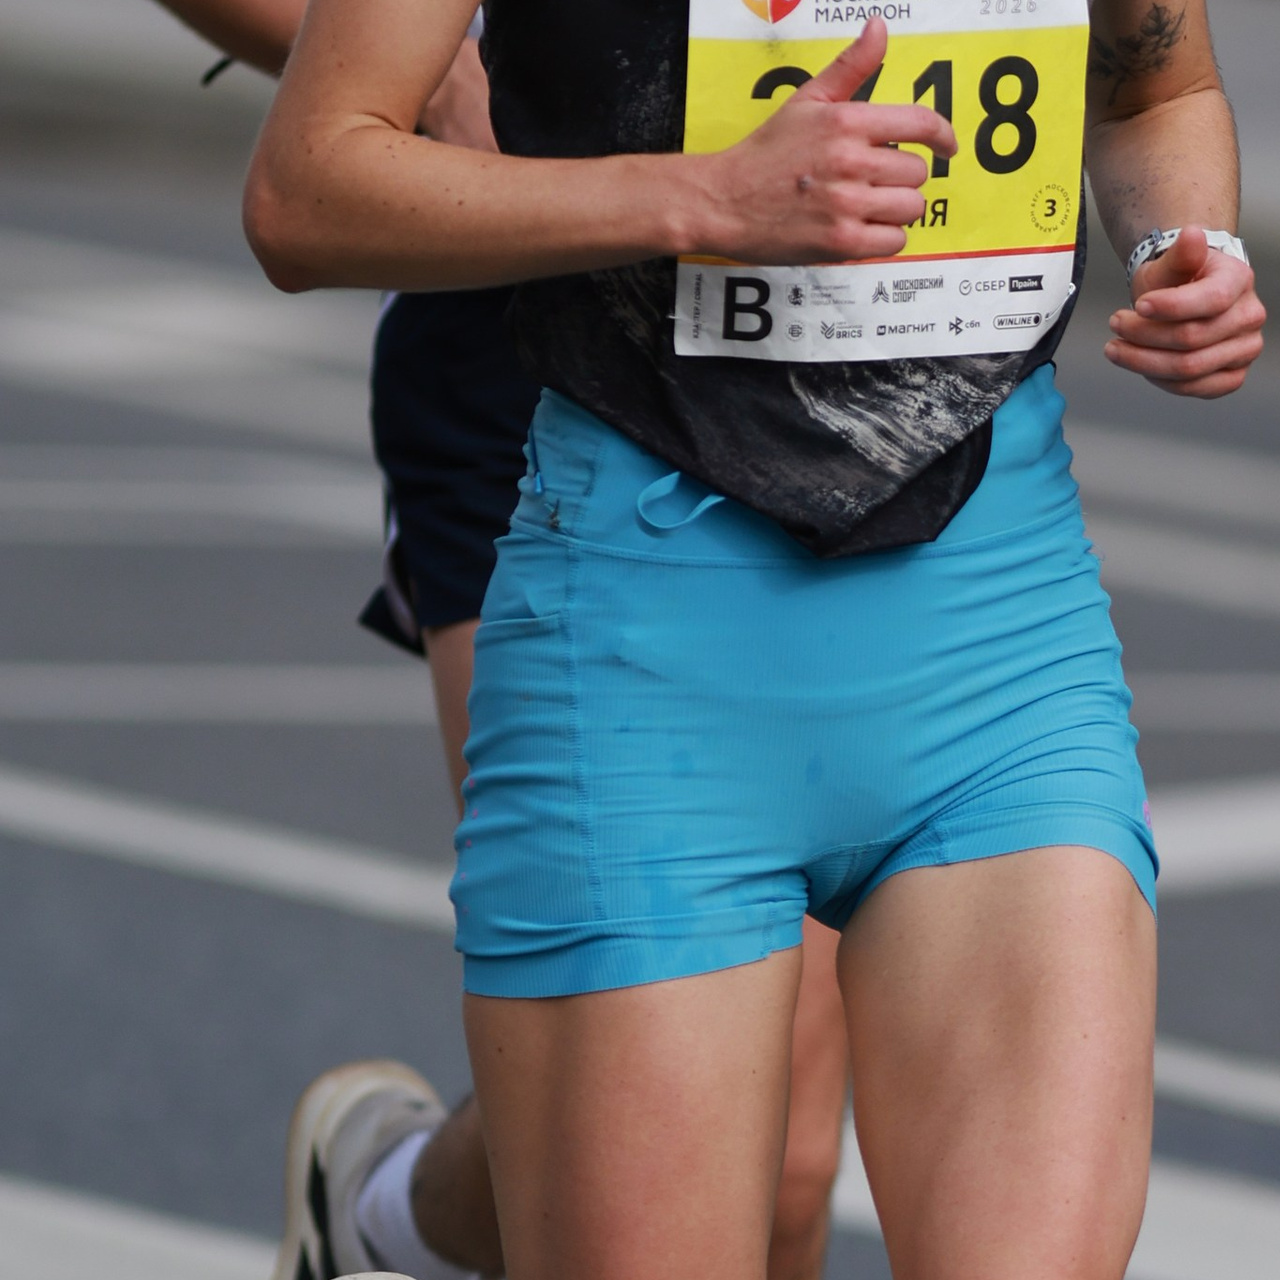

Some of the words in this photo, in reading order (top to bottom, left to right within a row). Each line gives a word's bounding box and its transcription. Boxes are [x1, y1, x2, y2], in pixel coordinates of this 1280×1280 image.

[815, 3, 911, 23] МАРАФОН
[751, 55, 1039, 178] 18
[1043, 198, 1057, 217] 3
[892, 274, 944, 290] МОСКОВСКИЙ
[974, 279, 1006, 292] СБЕР
[1011, 278, 1038, 289] Прайм
[892, 291, 917, 303] СПОРТ
[997, 316, 1033, 327] WINLINE
[836, 329, 863, 339] BRICS
